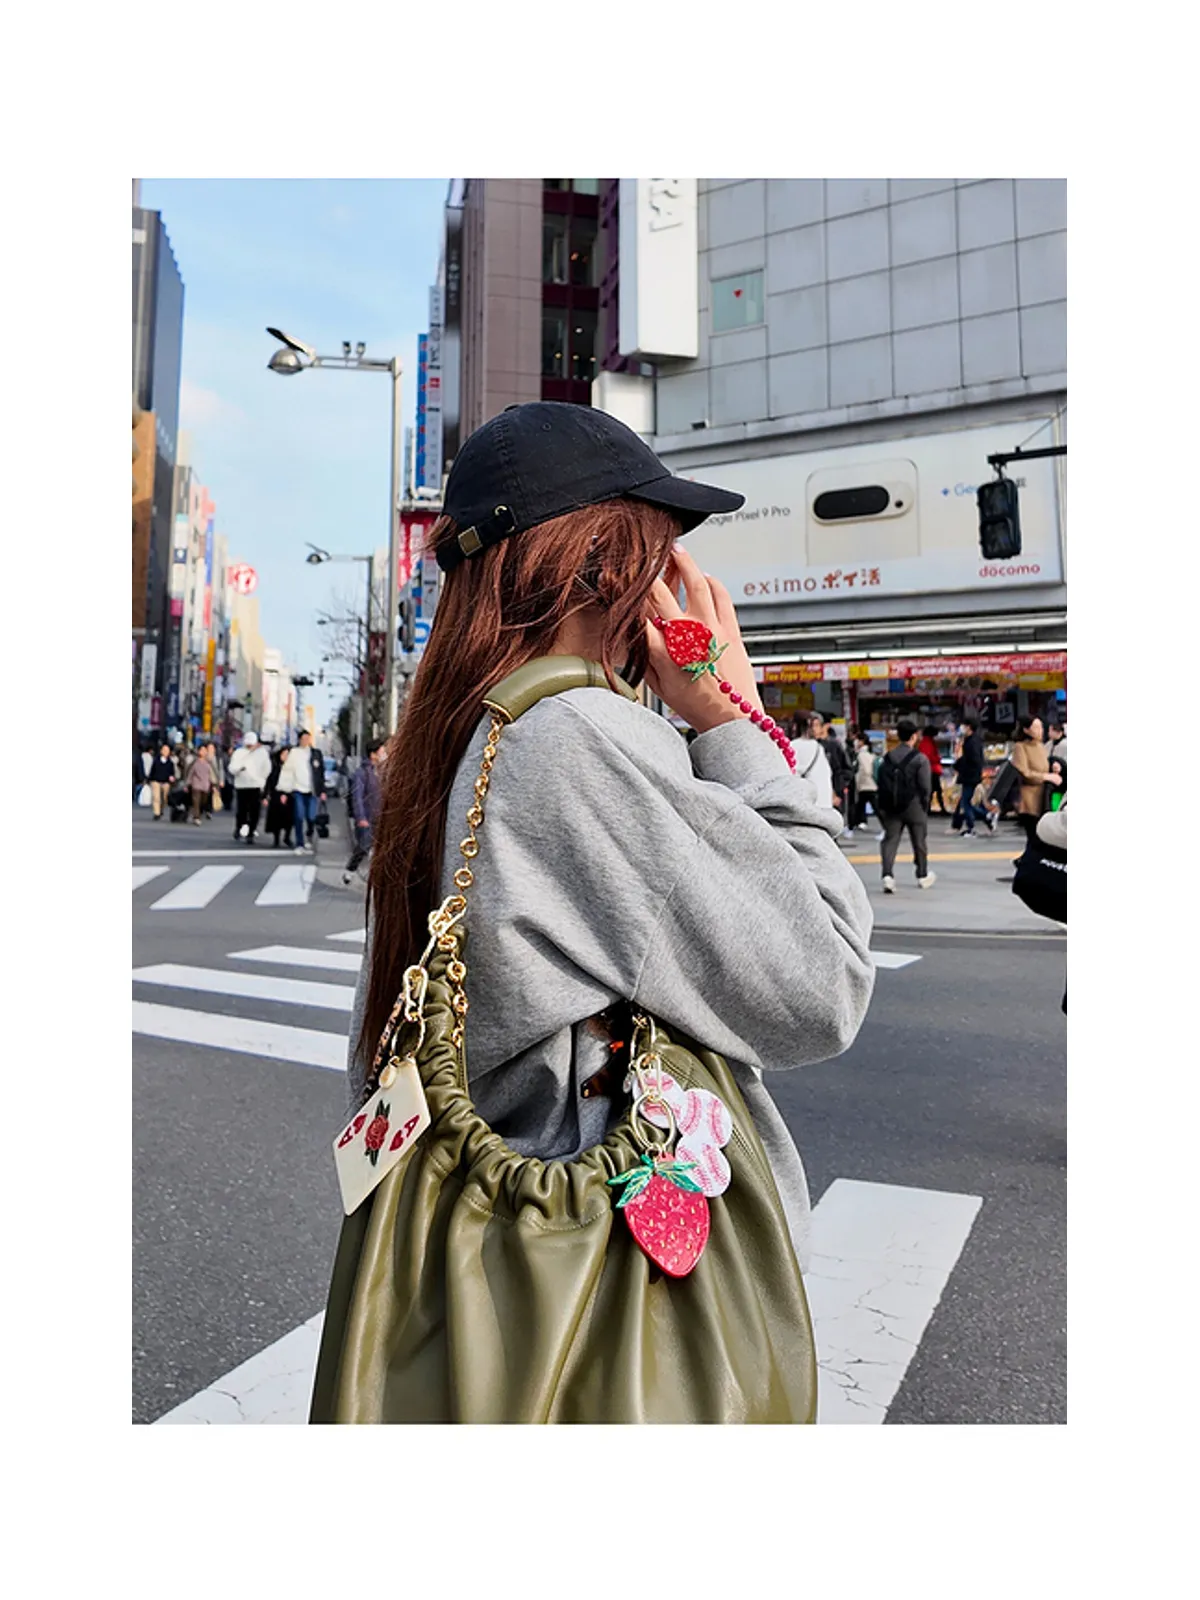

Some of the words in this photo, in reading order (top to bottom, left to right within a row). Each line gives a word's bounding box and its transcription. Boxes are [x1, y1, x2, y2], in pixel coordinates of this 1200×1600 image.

[735, 508, 759, 521] Pixel
[761, 507, 769, 517] 9
[771, 505, 791, 517] Pro
[979, 563, 1041, 578] docomo
[743, 577, 817, 596] eximo
[404, 1114, 420, 1138] A
[338, 1126, 354, 1149] A
